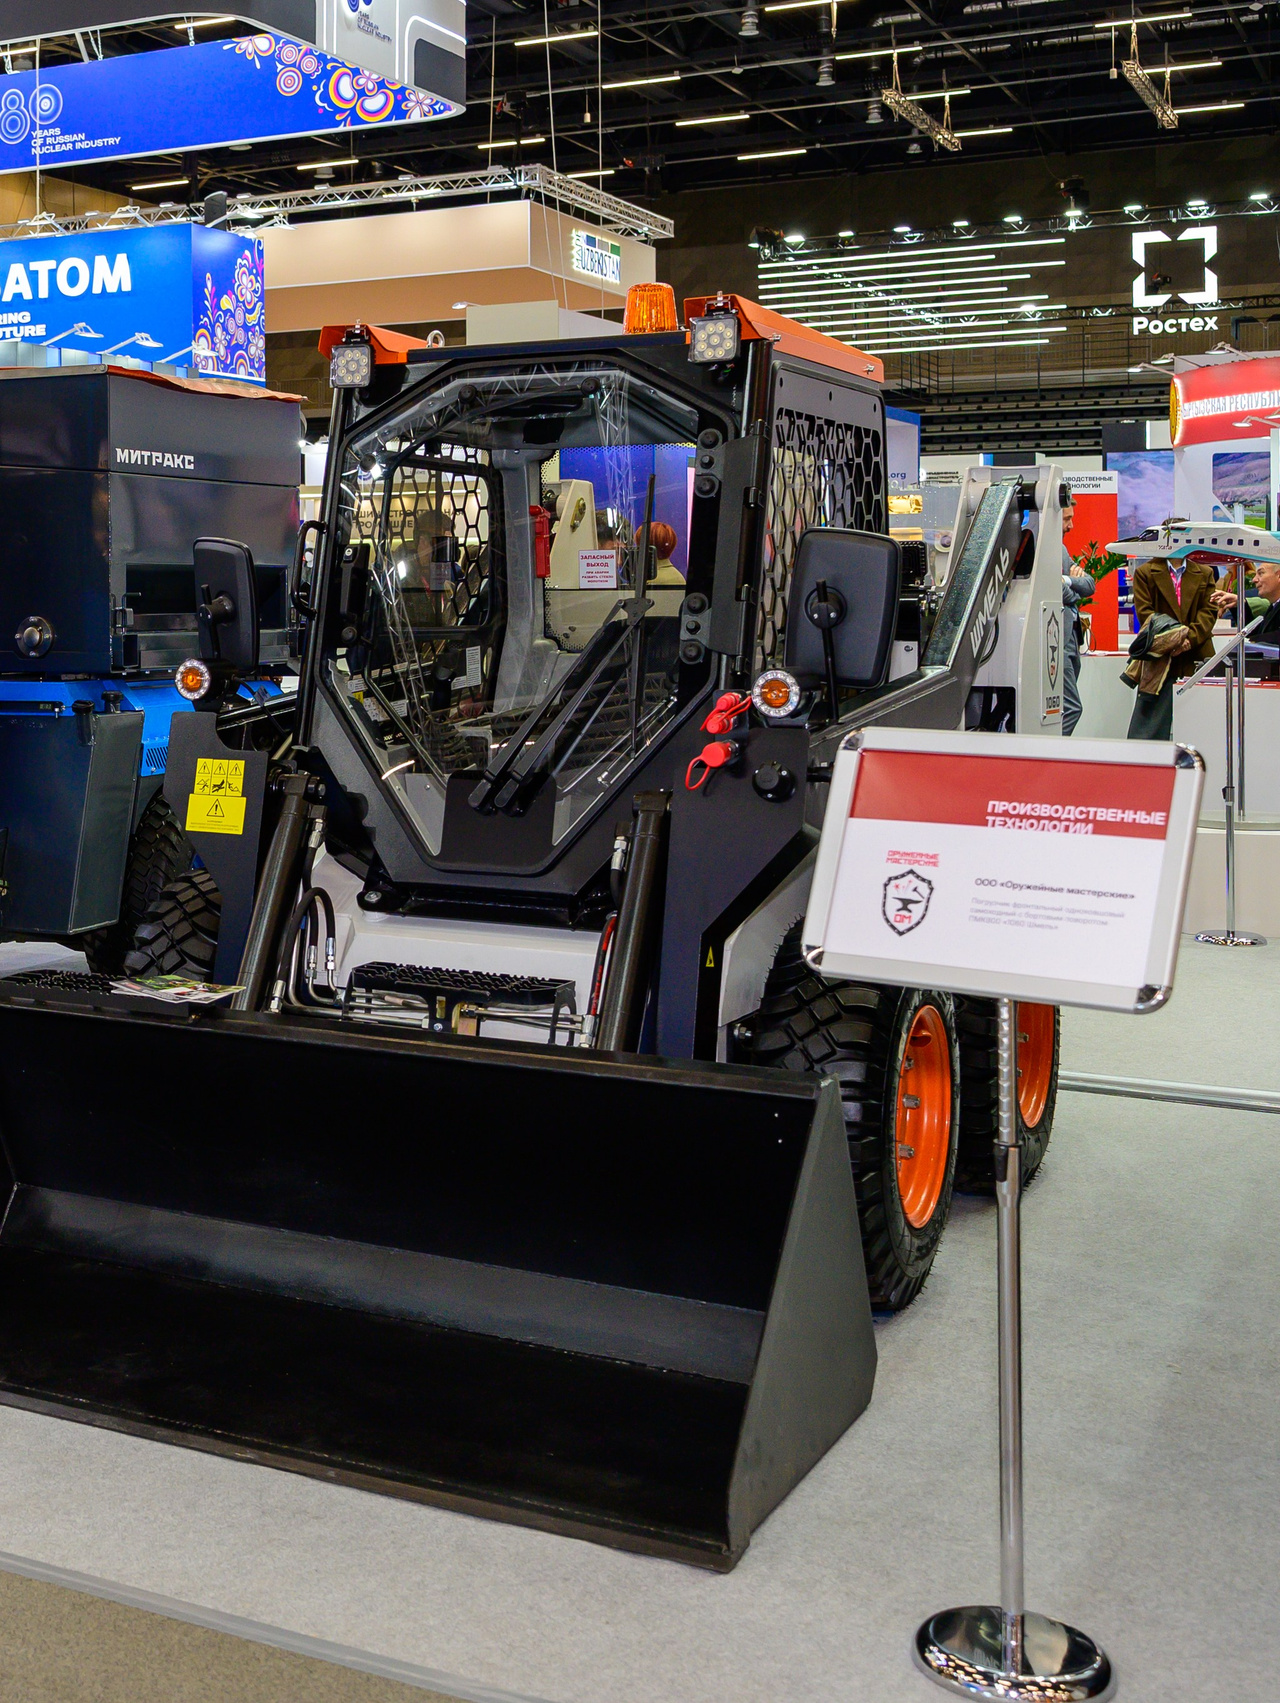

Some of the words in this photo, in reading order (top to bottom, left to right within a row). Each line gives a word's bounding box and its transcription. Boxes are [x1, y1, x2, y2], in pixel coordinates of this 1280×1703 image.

[31, 128, 61, 138] YEARS
[31, 139, 43, 147] OF
[46, 133, 85, 145] RUSSIAN
[31, 143, 73, 155] NUCLEAR
[75, 137, 121, 150] INDUSTRY
[581, 245, 620, 282] UZBEKISTAN
[1133, 316, 1219, 336] Ростех
[1229, 390, 1280, 412] РЕСПУБЛ
[115, 447, 195, 470] МИТРАКС
[970, 546, 1010, 658] ШМЕЛЬ
[986, 799, 1167, 826] ПРОИЗВОДСТВЕННЫЕ
[985, 815, 1095, 835] ТЕХНОЛОГИИ
[975, 878, 997, 887] ООО
[1000, 880, 1064, 893] «Оружейные
[1066, 887, 1135, 899] мастерские»
